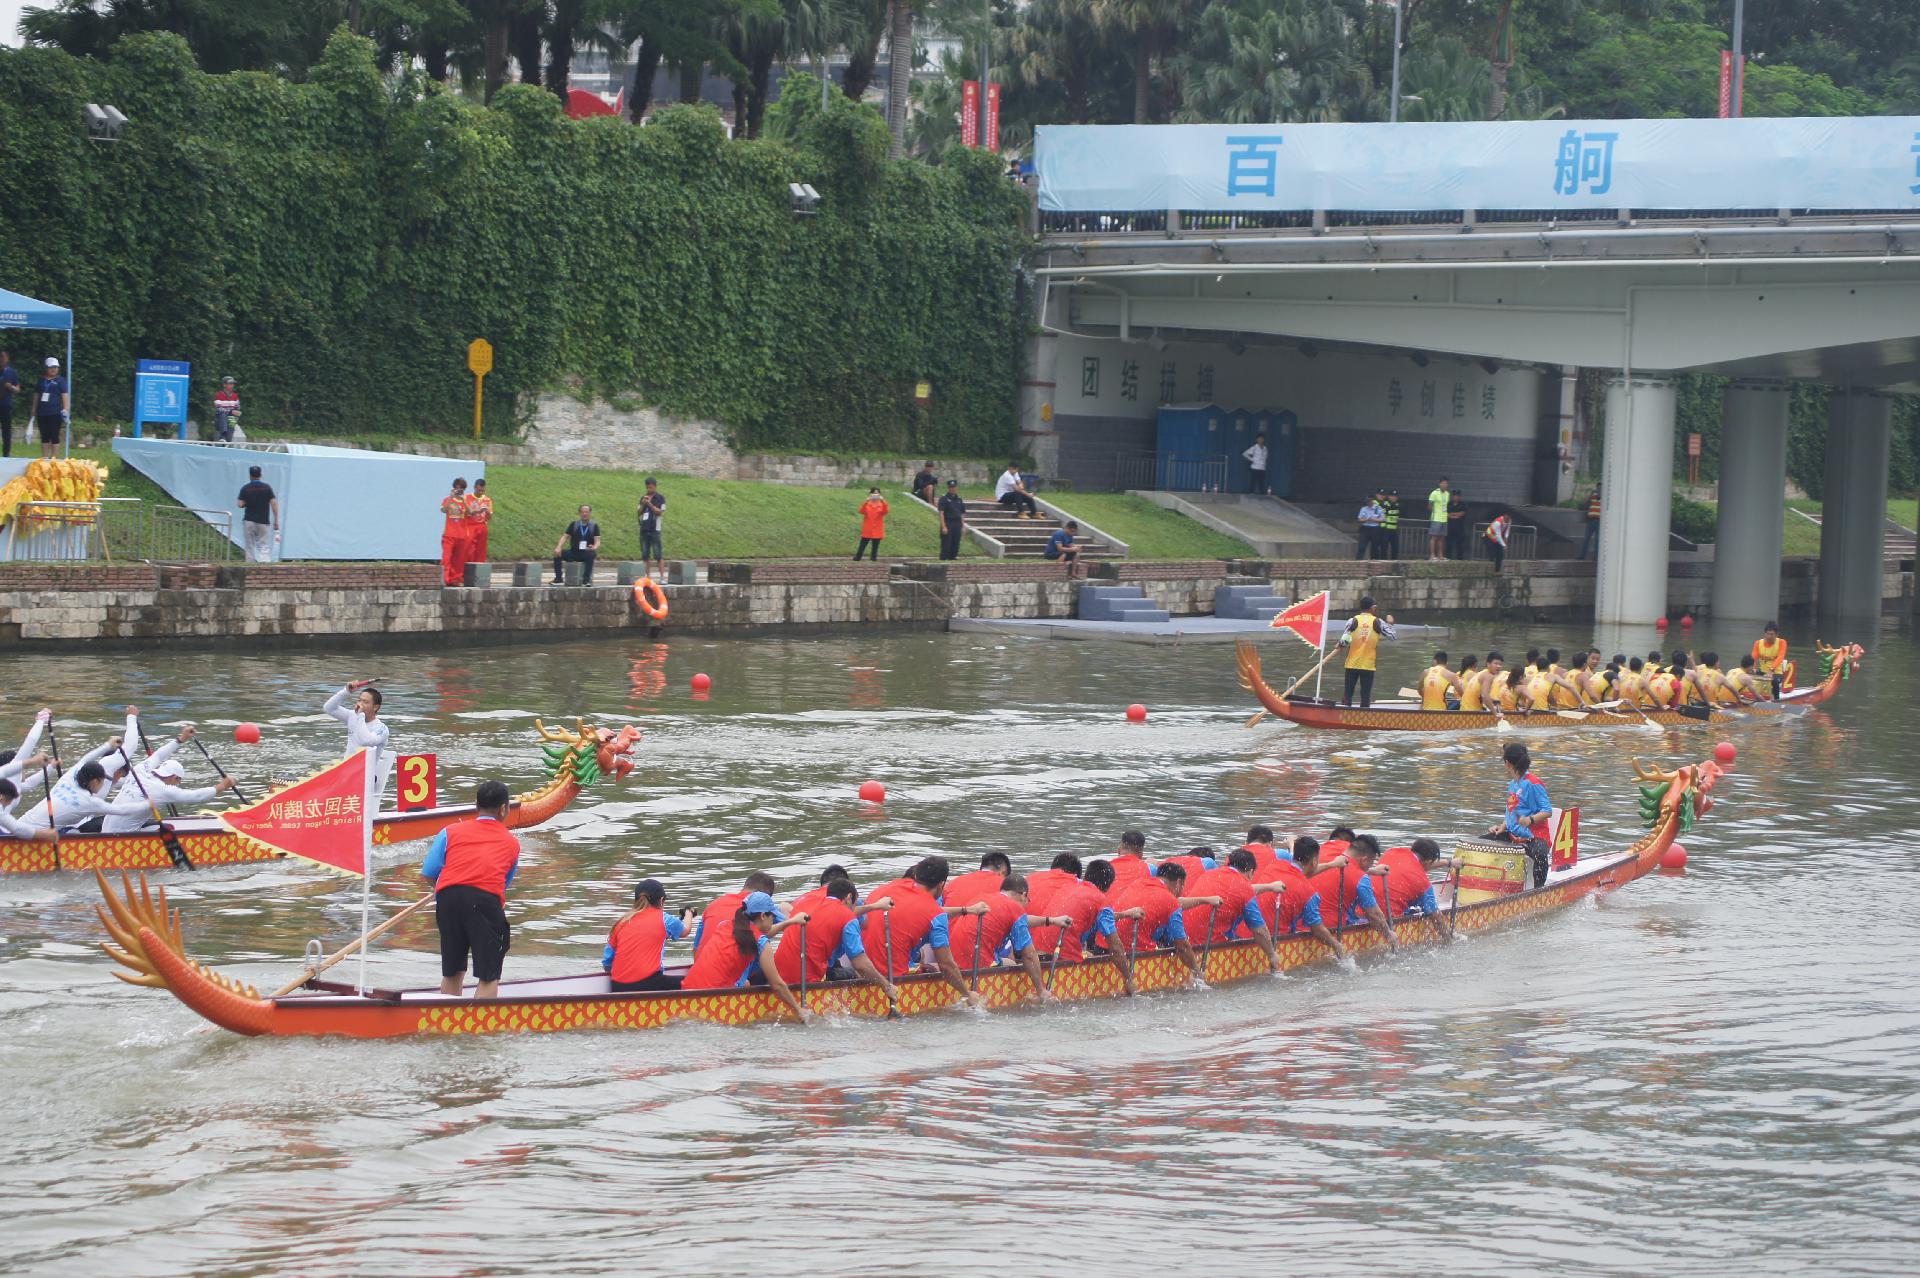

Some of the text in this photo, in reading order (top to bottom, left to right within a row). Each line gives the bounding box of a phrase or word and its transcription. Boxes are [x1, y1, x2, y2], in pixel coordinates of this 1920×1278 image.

[1783, 662, 1794, 689] 2
[403, 756, 429, 803] 3
[1555, 811, 1574, 859] 4
